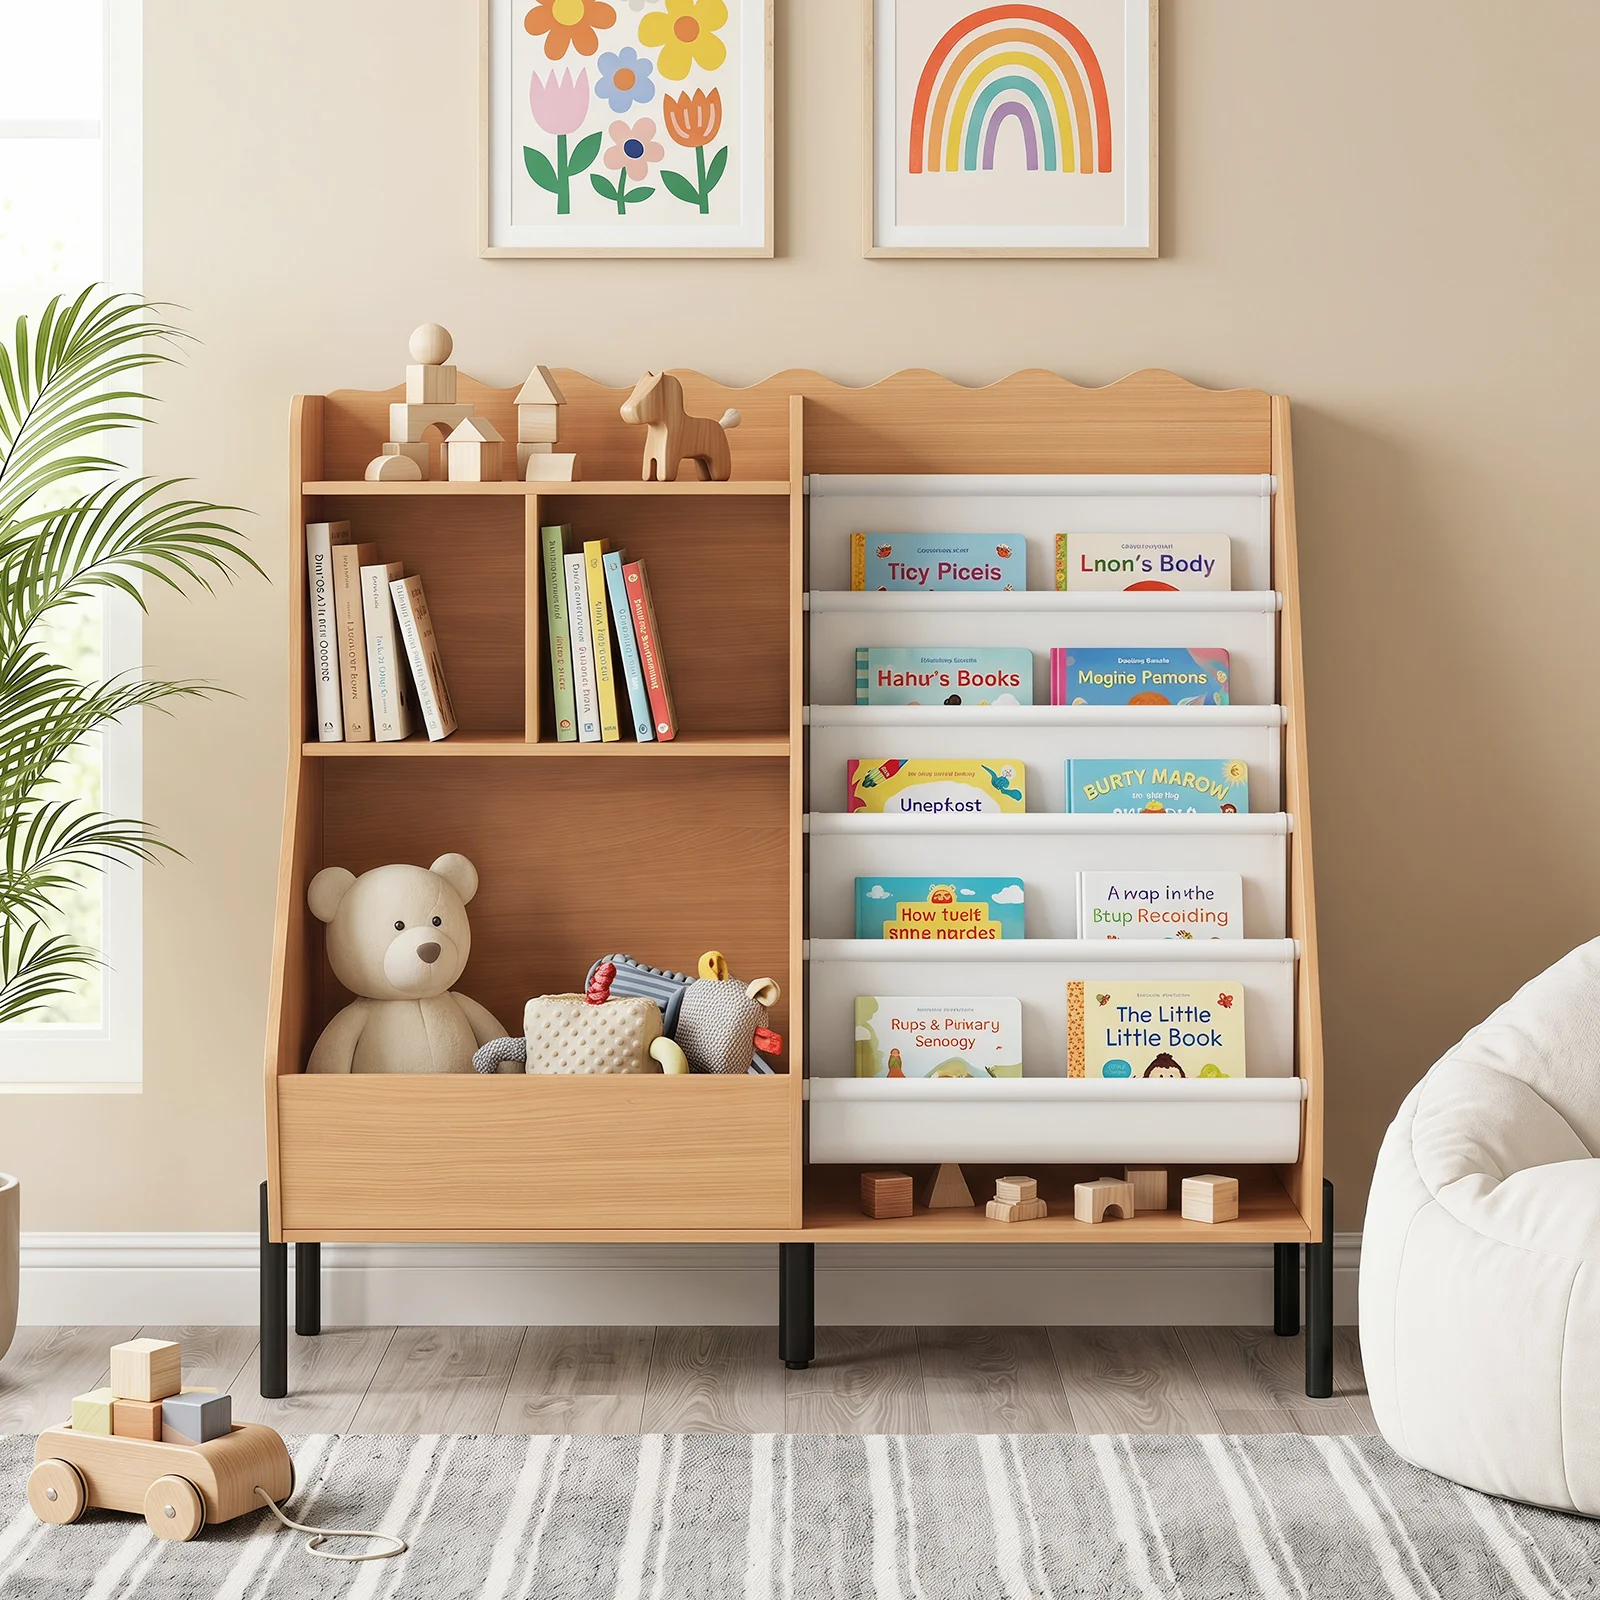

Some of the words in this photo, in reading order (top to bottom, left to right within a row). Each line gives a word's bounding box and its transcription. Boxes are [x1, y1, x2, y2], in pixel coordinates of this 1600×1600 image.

[888, 562, 930, 585] Ticy
[938, 562, 1002, 580] Piceis
[1160, 554, 1215, 578] Body
[958, 670, 1020, 686] Books
[1083, 768, 1147, 801] BURTY
[1151, 768, 1230, 801] MAROW
[901, 908, 937, 922] How
[1116, 1006, 1152, 1023] The
[1159, 1006, 1211, 1023] Little
[891, 1018, 926, 1033] Rups
[930, 1019, 940, 1031] &
[915, 1035, 976, 1051] Senoogy
[1106, 1028, 1161, 1047] Little
[1169, 1028, 1223, 1047] Book
